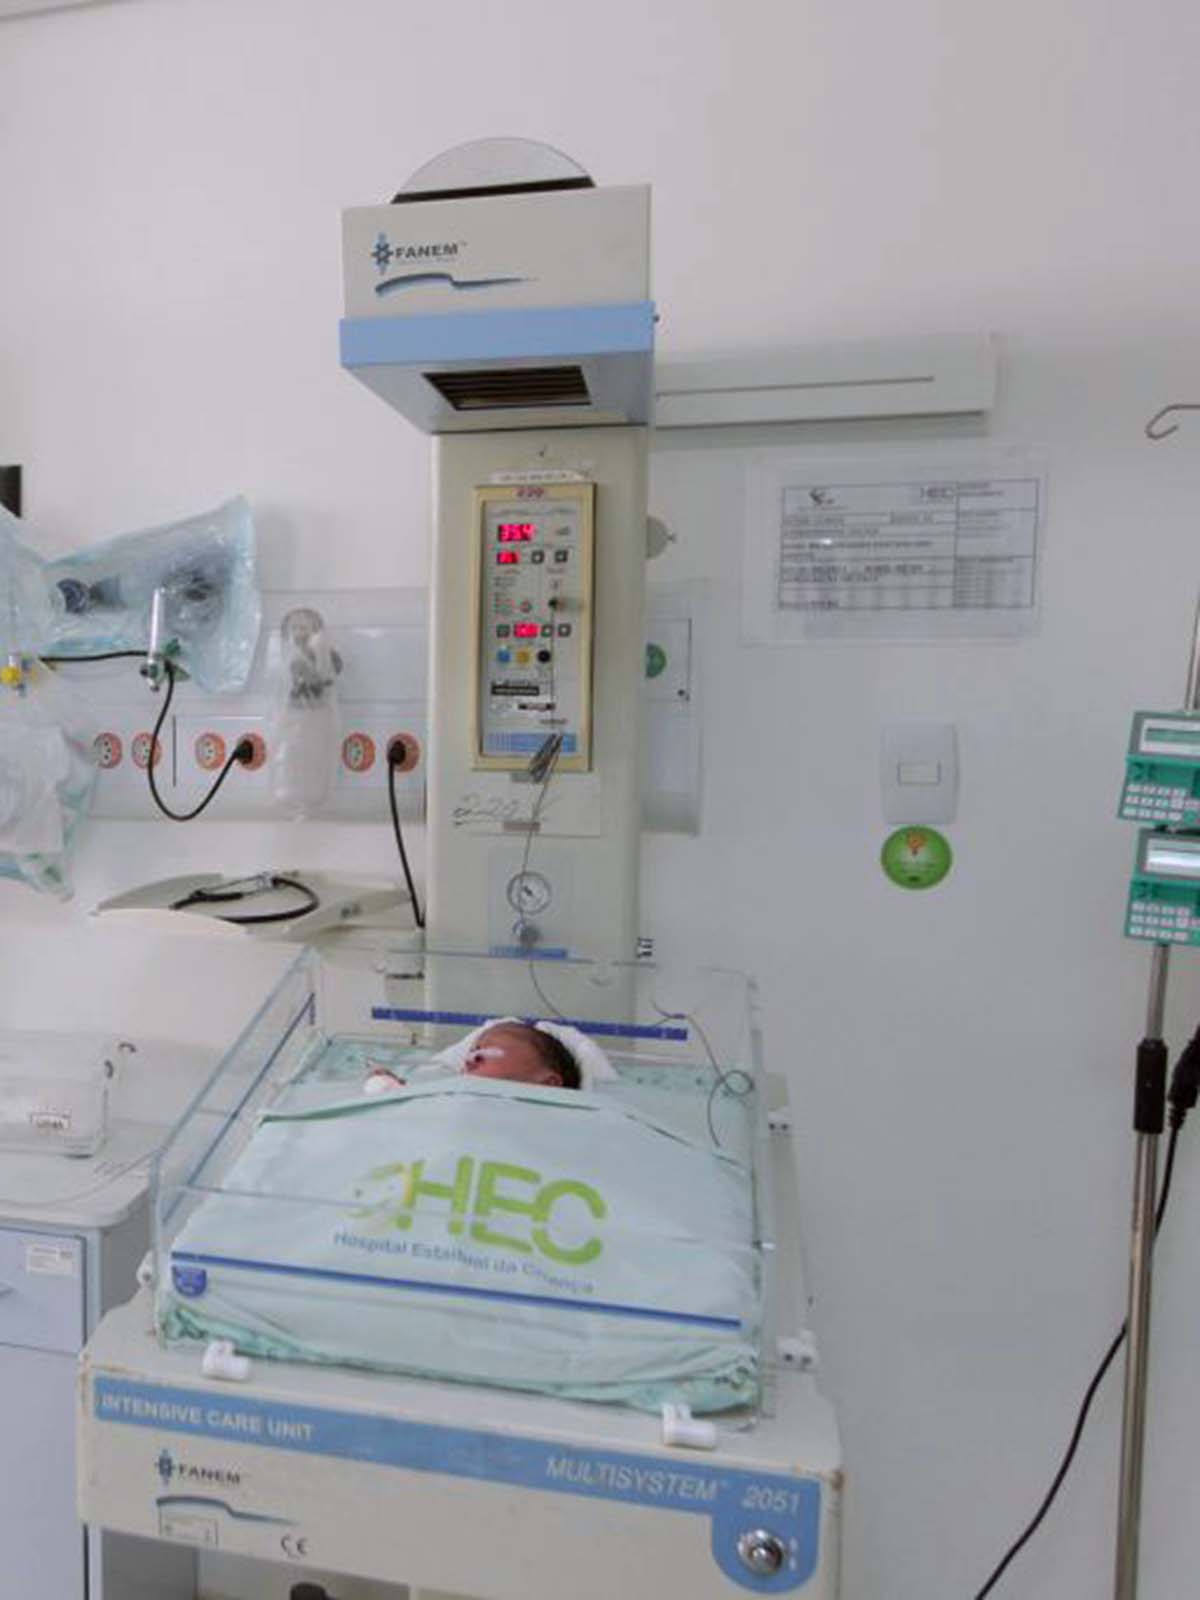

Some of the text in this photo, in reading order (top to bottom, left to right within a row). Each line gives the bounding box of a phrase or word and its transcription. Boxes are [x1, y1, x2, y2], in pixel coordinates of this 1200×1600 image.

[395, 243, 459, 260] FANEM
[396, 1154, 607, 1265] HEC
[334, 1231, 407, 1254] Hospital
[101, 1394, 314, 1441] INTENSIVE CARE UNIT
[176, 1462, 241, 1485] FANEM
[742, 1485, 799, 1514] 2051
